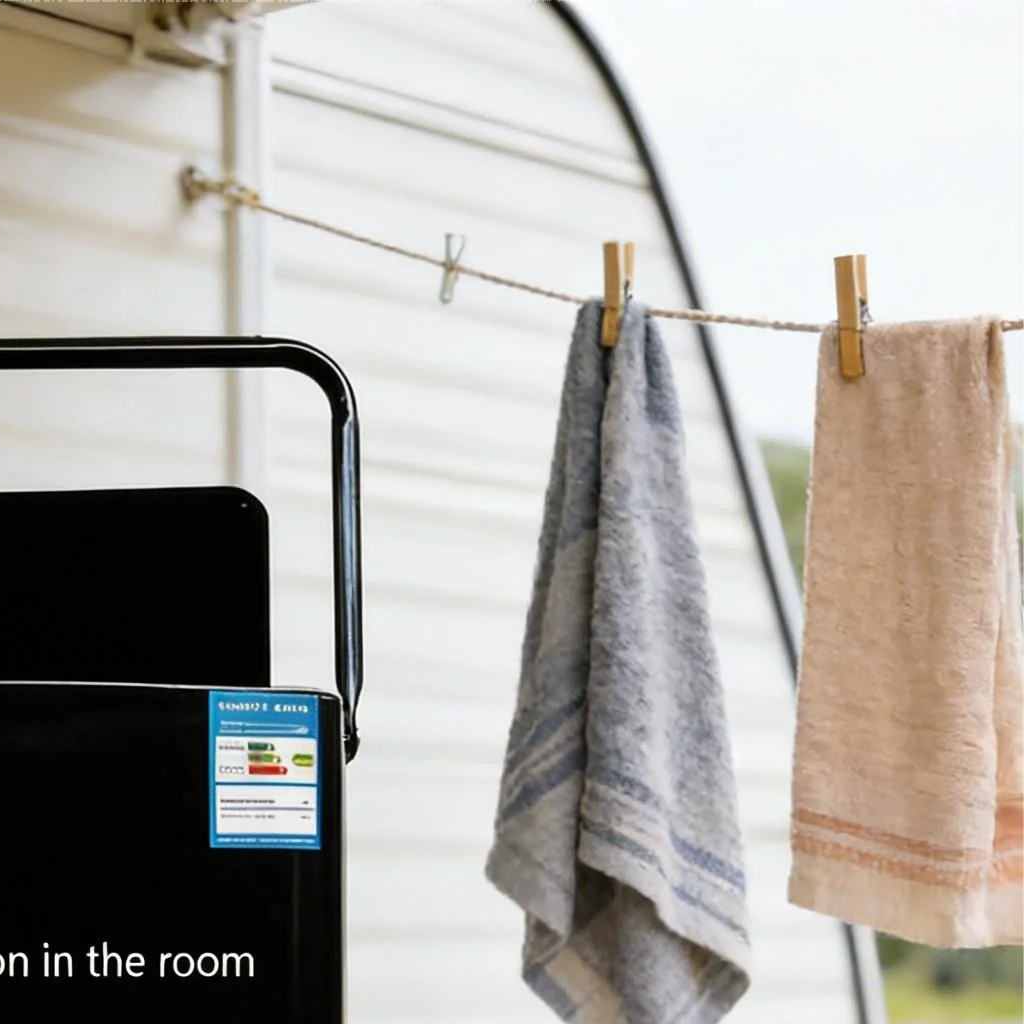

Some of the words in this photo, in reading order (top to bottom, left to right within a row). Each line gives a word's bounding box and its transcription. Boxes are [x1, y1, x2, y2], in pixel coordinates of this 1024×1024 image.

[42, 943, 73, 978] in
[85, 941, 146, 978] the
[159, 952, 255, 978] room
